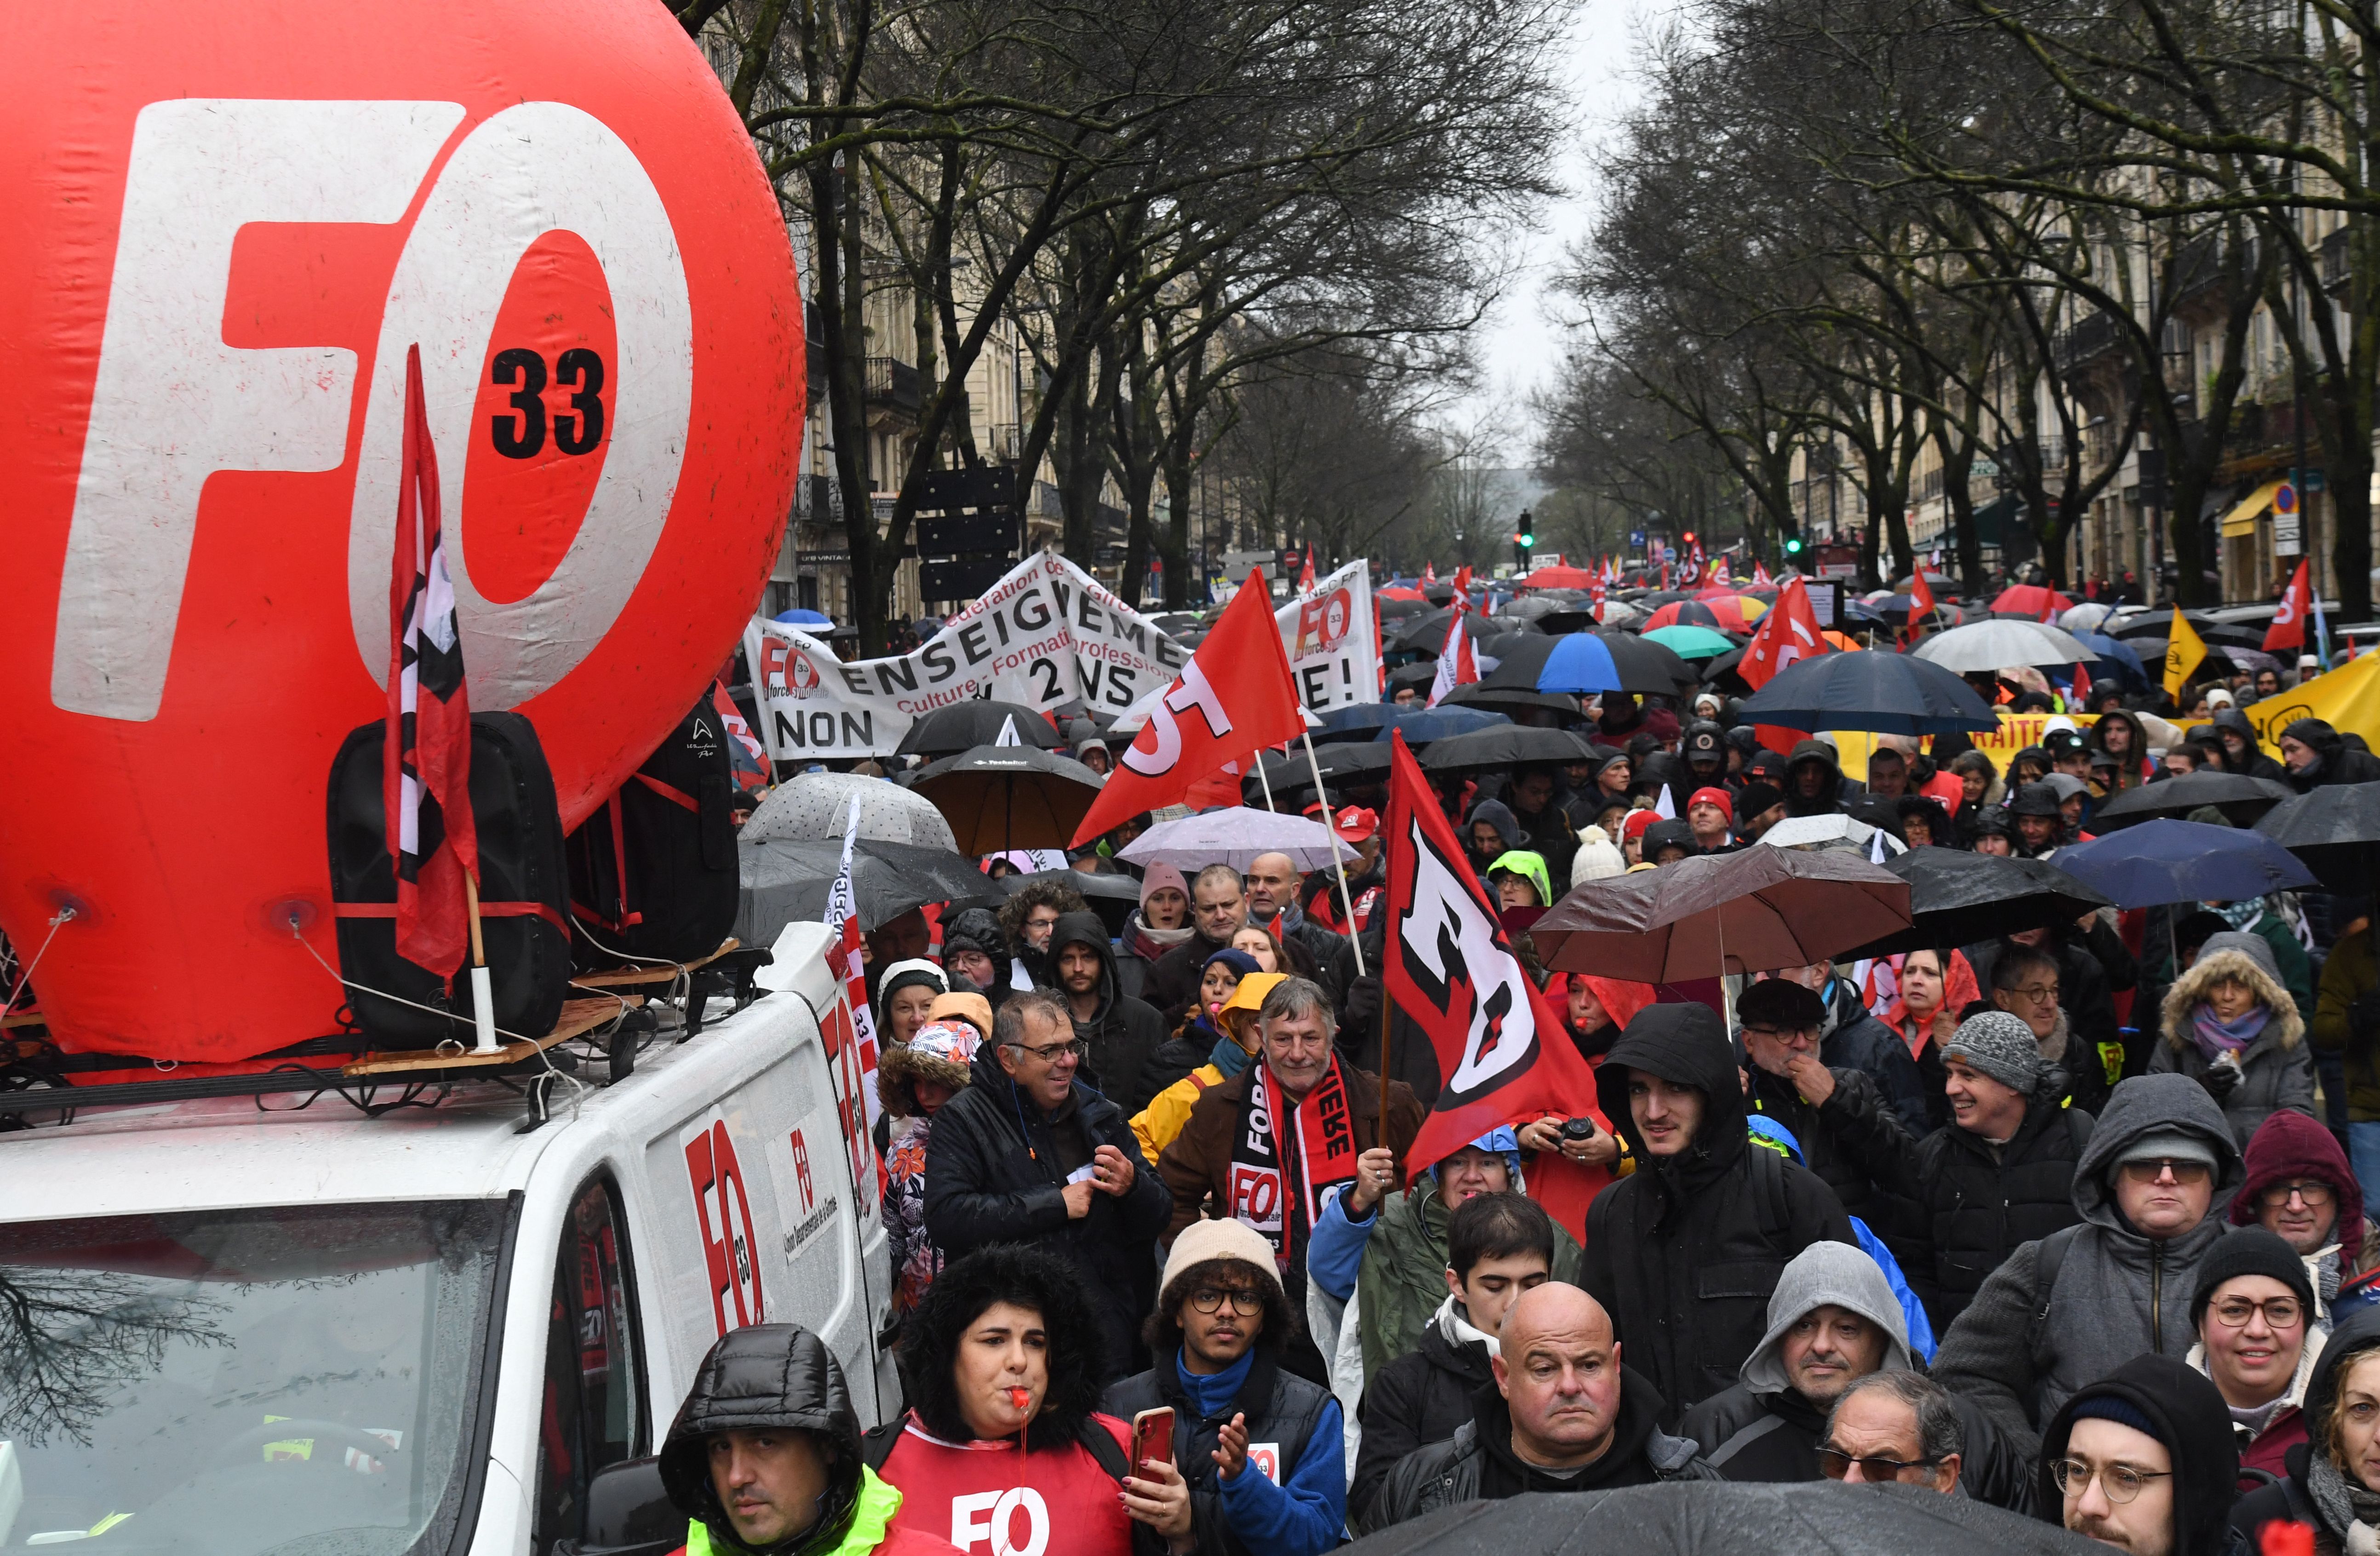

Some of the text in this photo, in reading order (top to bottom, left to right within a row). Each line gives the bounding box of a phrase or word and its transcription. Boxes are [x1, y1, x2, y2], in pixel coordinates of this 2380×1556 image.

[51, 98, 692, 722] FO
[491, 348, 605, 458] 33
[1293, 588, 1351, 663] FO
[1330, 613, 1342, 623] 33
[761, 637, 820, 701] FO
[769, 683, 790, 698] force
[798, 664, 809, 673] 33
[897, 679, 977, 714] Culture
[775, 709, 873, 749] NON
[790, 1127, 813, 1216] FO
[685, 1119, 764, 1338] FO
[735, 1234, 750, 1286] 33
[951, 1486, 1050, 1556] FO
